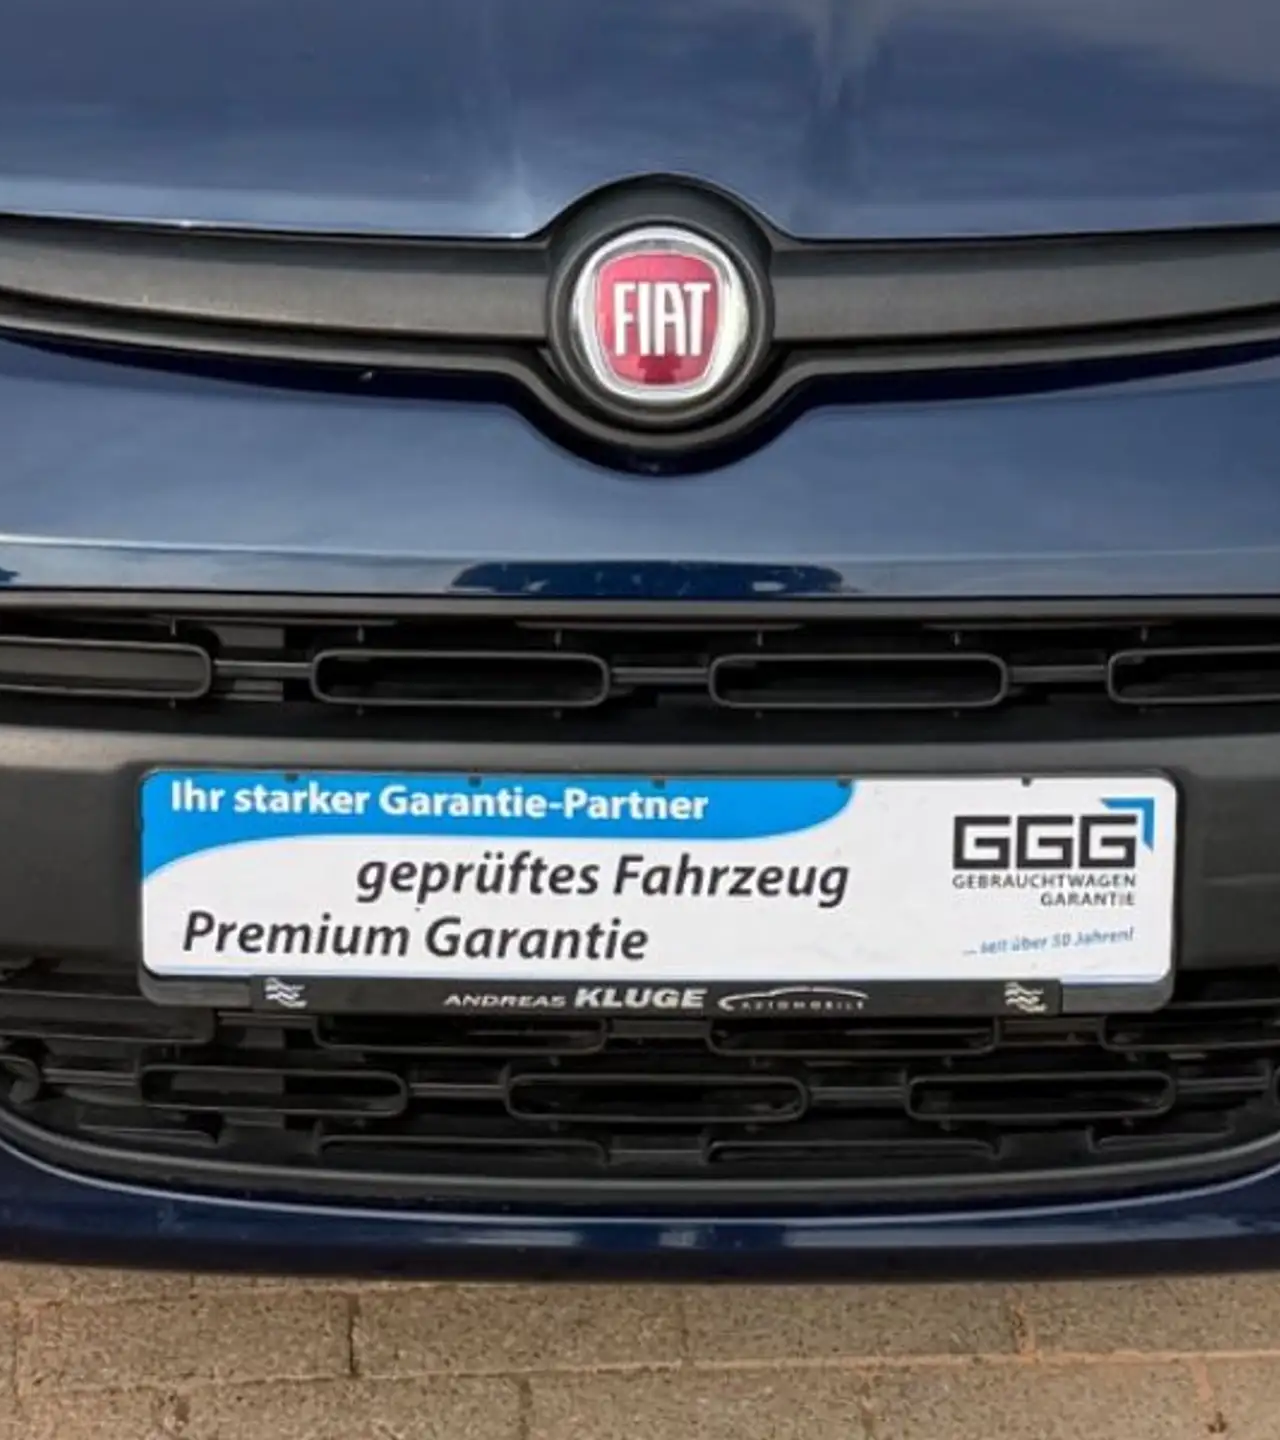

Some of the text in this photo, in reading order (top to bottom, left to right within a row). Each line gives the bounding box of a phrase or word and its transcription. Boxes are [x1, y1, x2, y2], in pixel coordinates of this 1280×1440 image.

[614, 282, 711, 356] FIAT
[171, 780, 709, 820] Ihr starker Garantie-Partner
[953, 814, 1137, 870] GGG
[357, 850, 849, 908] geprüftes Fahrzeug
[952, 873, 1137, 889] GEBRAUCHTWAGEN
[1040, 891, 1136, 906] GARANTIE
[183, 910, 649, 960] Premium Garantie
[443, 993, 567, 1008] ANDREAS
[574, 987, 708, 1009] KLUGE
